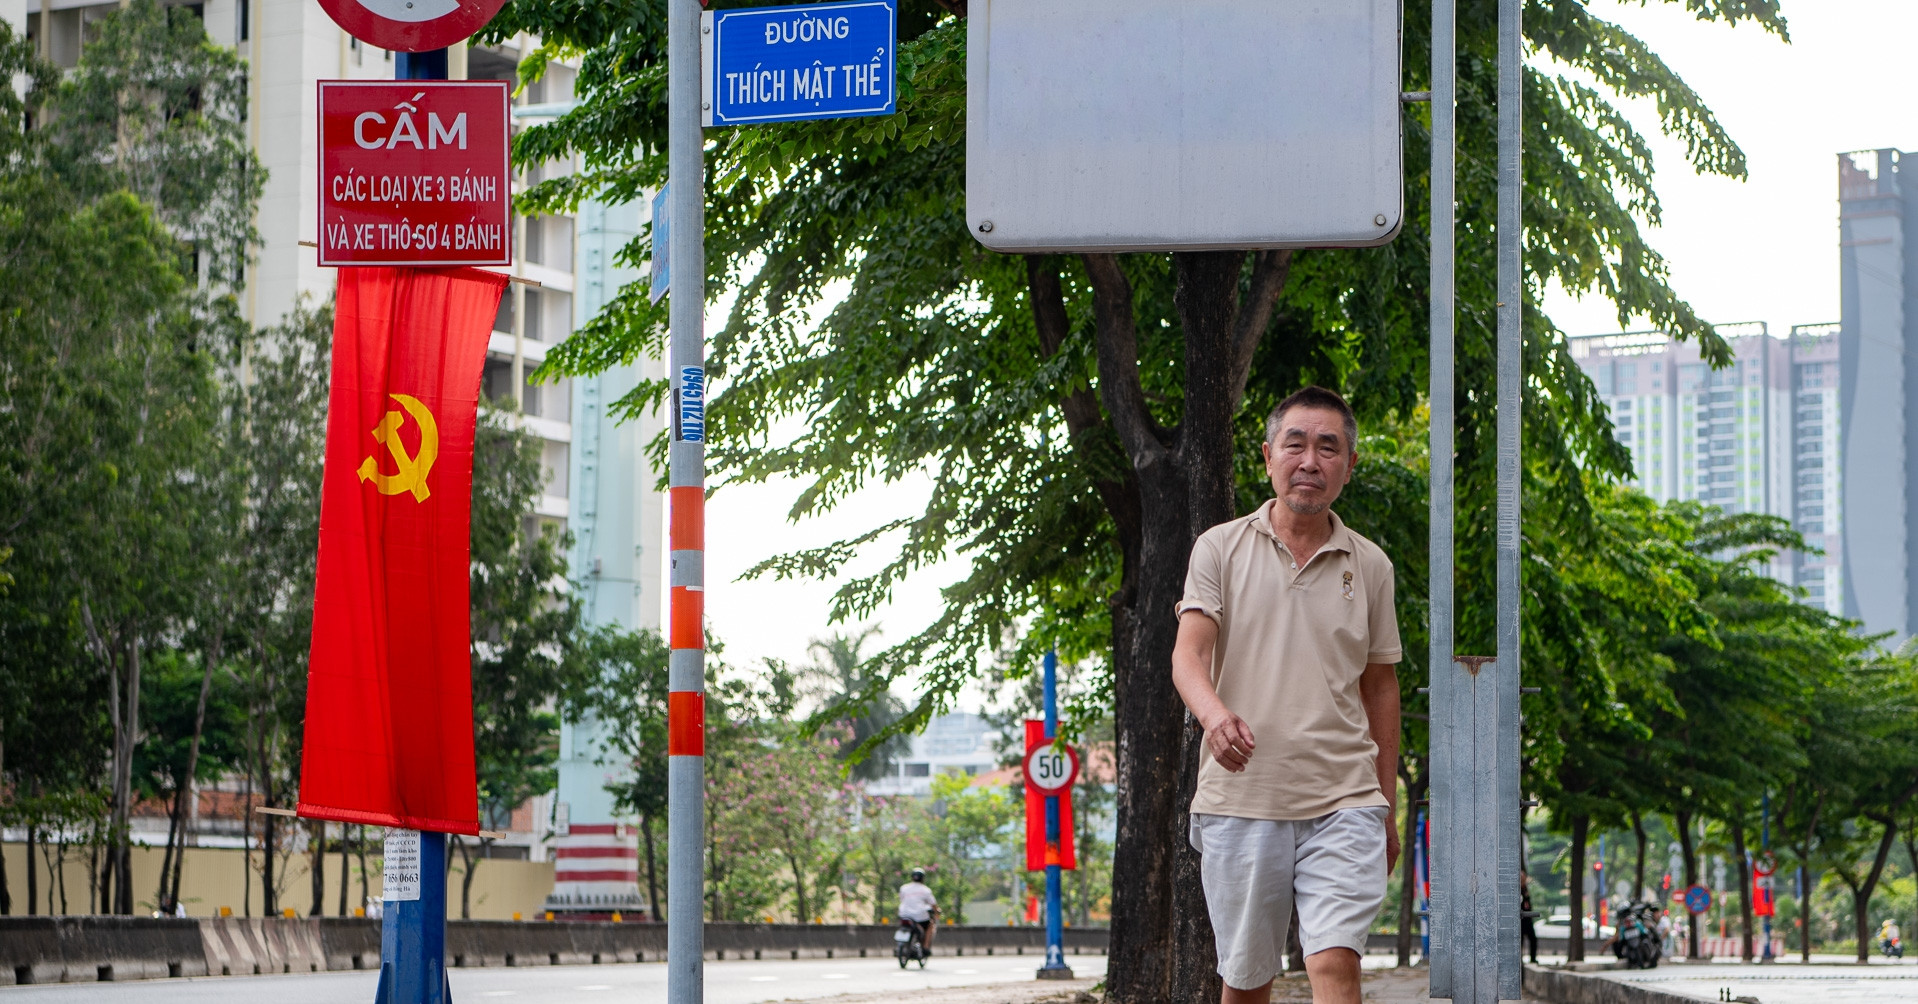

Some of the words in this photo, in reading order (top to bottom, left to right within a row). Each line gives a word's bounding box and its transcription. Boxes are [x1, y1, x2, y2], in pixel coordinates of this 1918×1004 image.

[765, 13, 849, 45] ĐƯỜNG
[726, 62, 785, 105] THÍCH
[793, 60, 836, 107] MẬT
[842, 47, 884, 98] THỂ
[353, 92, 467, 150] CẤM
[333, 168, 366, 201] CÁC
[370, 175, 407, 208] LOẠI
[412, 175, 433, 201] XE
[436, 175, 445, 201] 3
[450, 168, 496, 201] BÁNH
[327, 216, 350, 250] VÀ
[353, 223, 375, 250] XE
[378, 217, 411, 250] THÔ
[415, 221, 437, 250] SƠ
[441, 224, 450, 250] 4
[455, 216, 500, 250] BÁNH
[682, 367, 703, 442] 0945.112.116
[1040, 755, 1063, 778] 50
[399, 873, 419, 883] 0663
